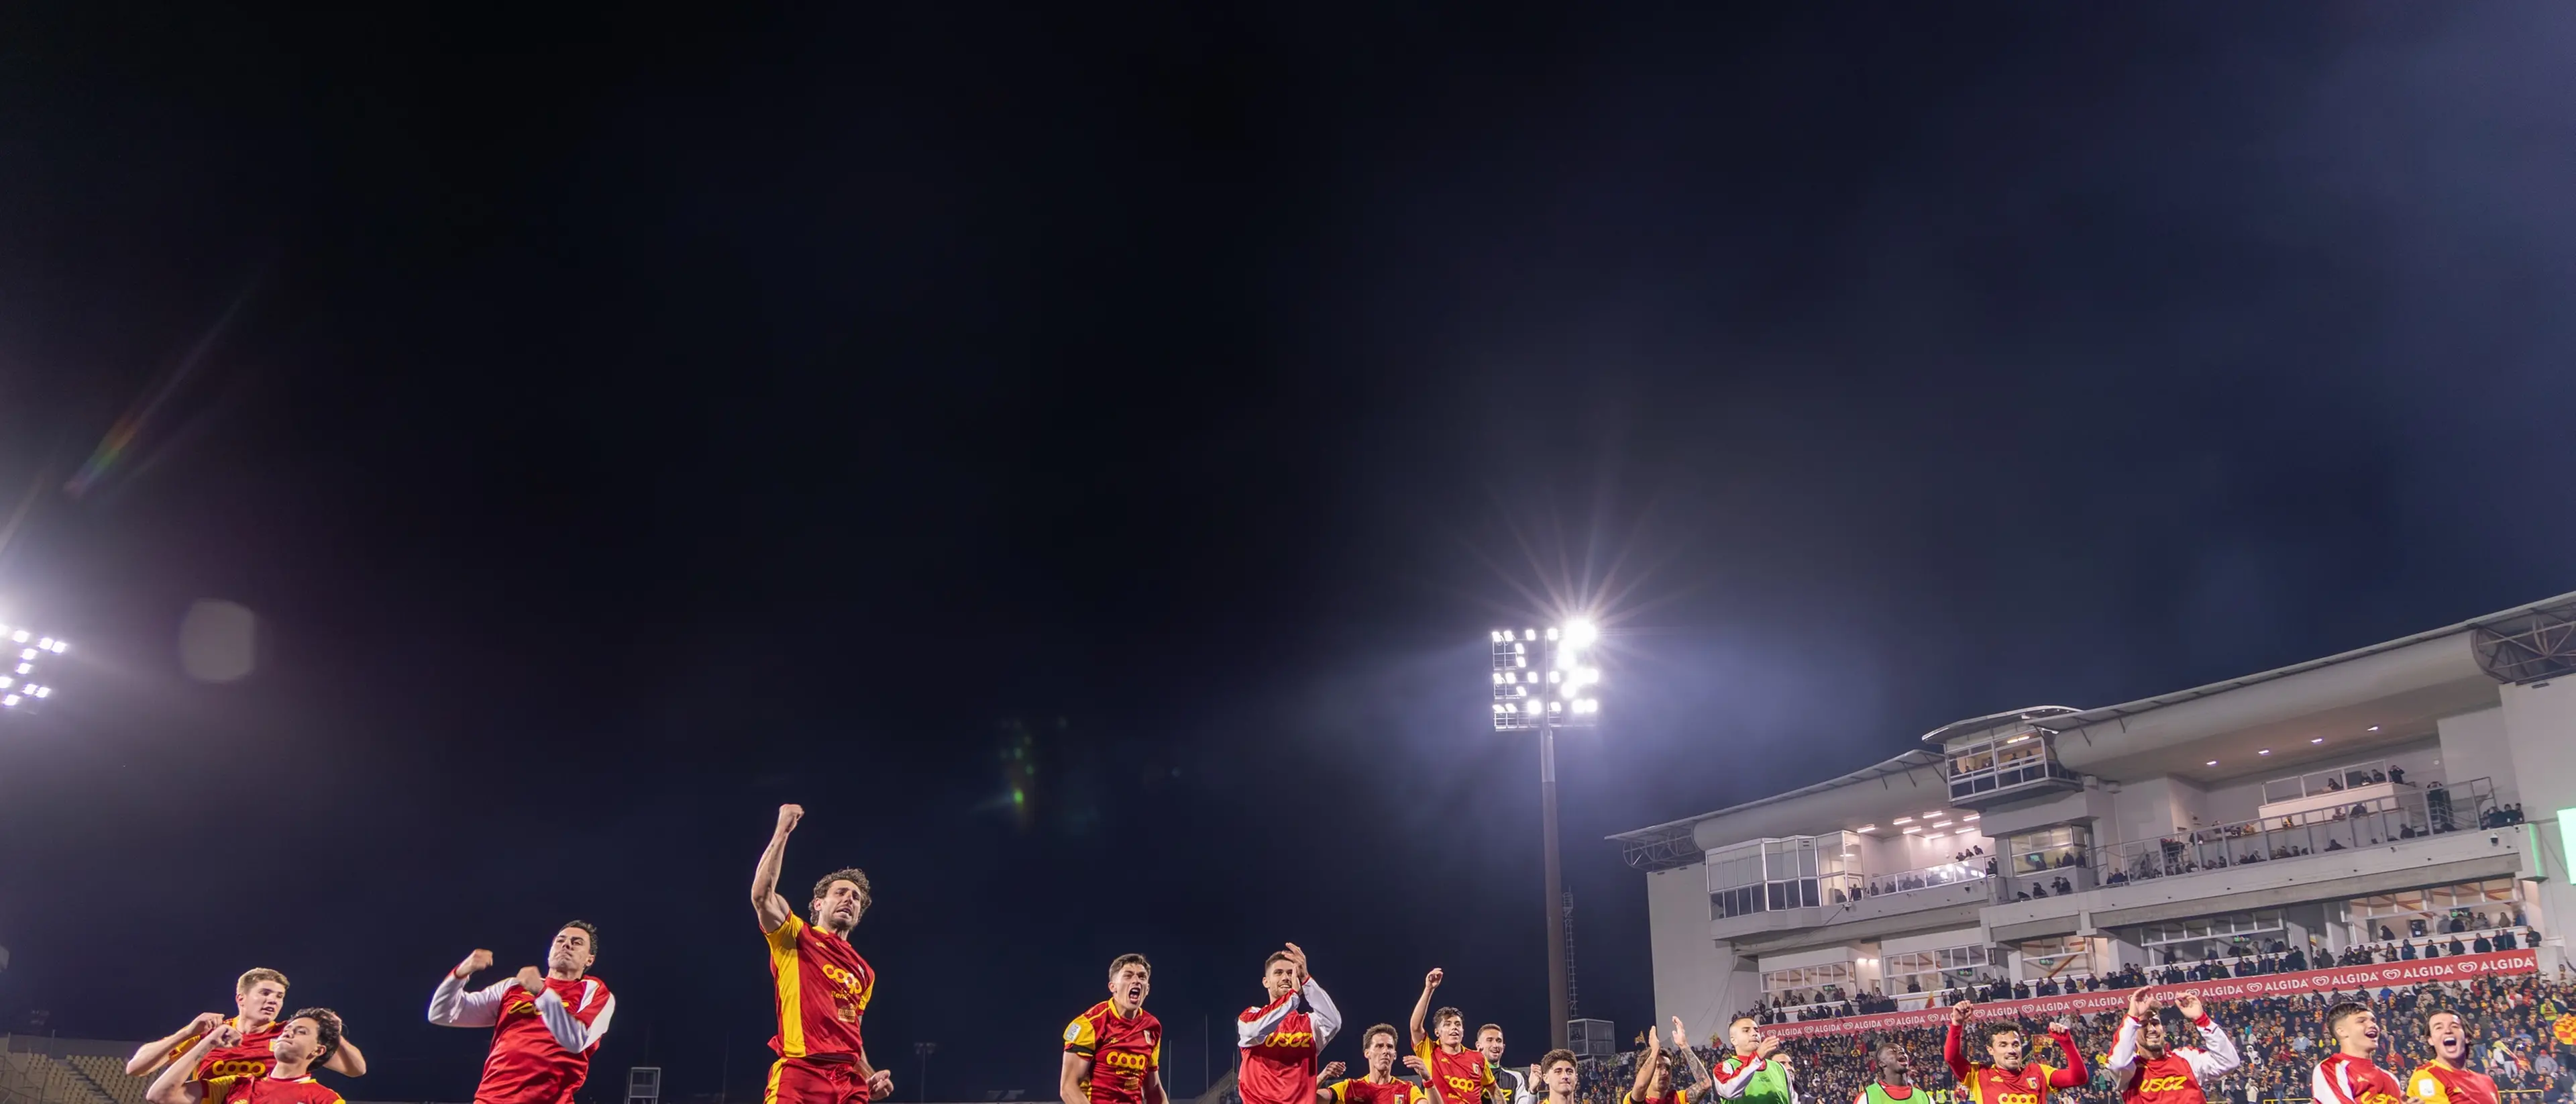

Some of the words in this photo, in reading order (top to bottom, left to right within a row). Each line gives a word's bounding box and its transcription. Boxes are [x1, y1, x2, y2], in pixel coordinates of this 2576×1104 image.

[1778, 1028, 1803, 1036] ALGIDA
[1815, 1024, 1841, 1033] ALGIDA
[1854, 1019, 1882, 1030] ALGIDA
[1896, 1016, 1925, 1025] ALGIDA
[1986, 1007, 2019, 1017] ALGIDA
[2035, 1002, 2070, 1012] ALGIDA
[2088, 997, 2125, 1007] ALGIDA
[2202, 985, 2243, 997] ALGIDA
[2264, 978, 2308, 991] ALGIDA
[2332, 972, 2379, 985] ALGIDA
[2404, 965, 2454, 978] ALGIDA
[2480, 957, 2534, 971] ALGIDA
